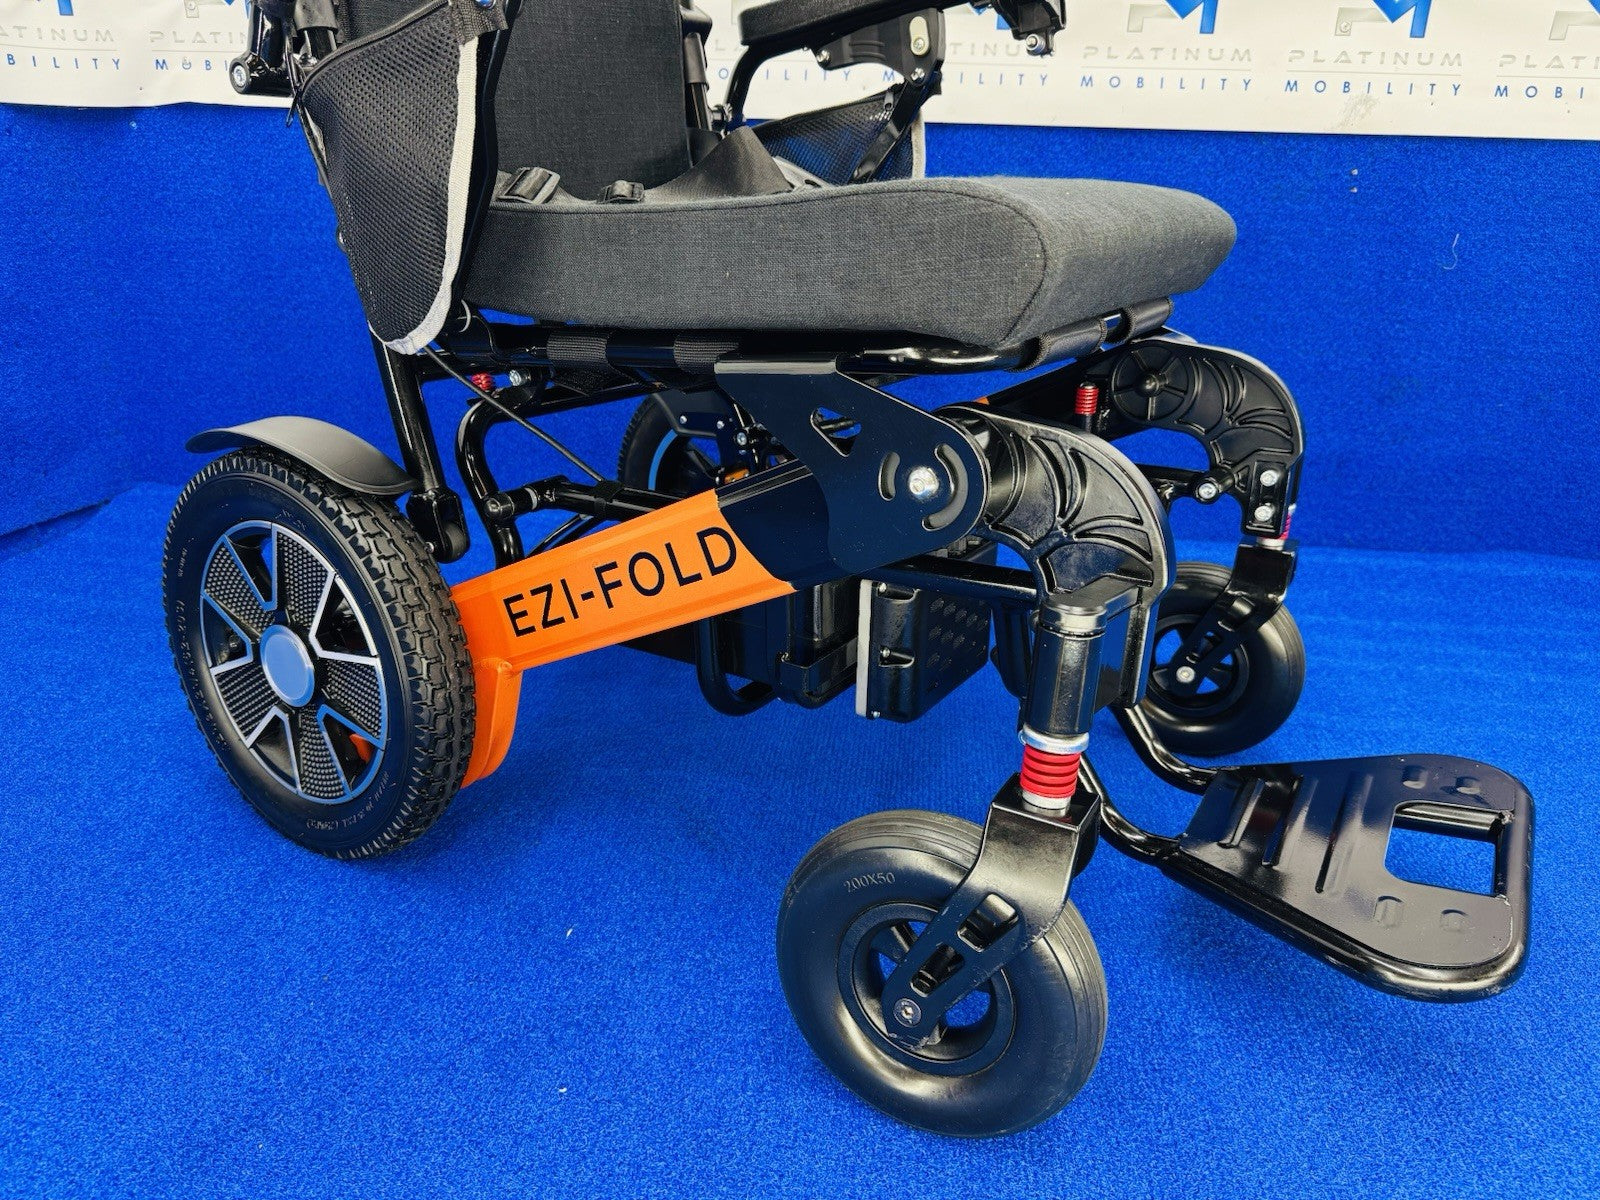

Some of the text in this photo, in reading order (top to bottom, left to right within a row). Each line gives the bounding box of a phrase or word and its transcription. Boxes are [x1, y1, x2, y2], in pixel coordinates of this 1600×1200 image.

[1083, 46, 1252, 62] PLATINUM
[1288, 50, 1463, 67] PLATINUM
[1080, 75, 1251, 91] MOBILITY
[1285, 80, 1461, 96] MOBILITY
[503, 526, 738, 638] EZI-FOLD
[843, 871, 896, 893] 200X50
